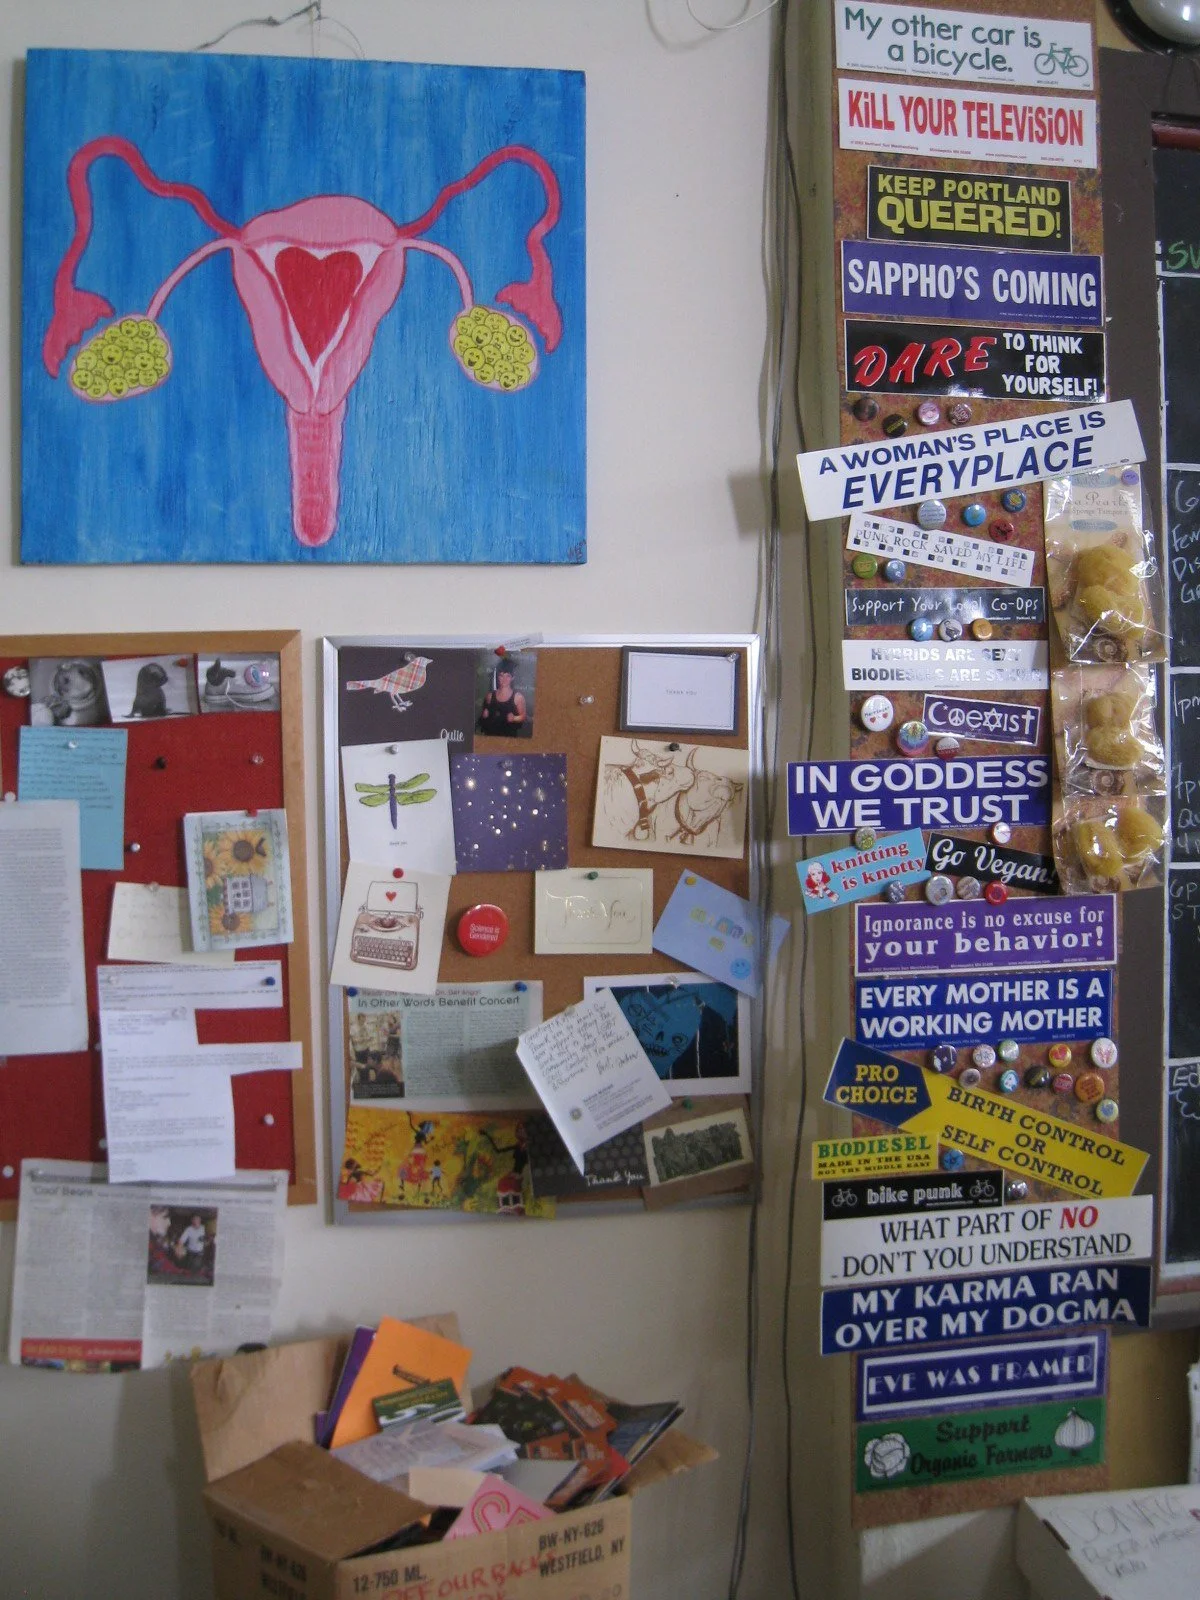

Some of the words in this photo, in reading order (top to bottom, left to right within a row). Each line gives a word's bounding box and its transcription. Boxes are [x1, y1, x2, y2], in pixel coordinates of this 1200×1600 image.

[845, 7, 882, 39] My
[892, 15, 963, 41] other
[971, 23, 1016, 47] car
[1023, 26, 1042, 49] is
[887, 43, 904, 62] a
[913, 40, 1013, 75] bicycle.
[899, 94, 958, 137] YOUR
[877, 173, 937, 197] KEEP
[943, 180, 1061, 207] PORTLAND
[877, 196, 1061, 239] QUEERED!
[848, 258, 981, 301] SAPPHO'S
[992, 268, 1097, 308] COMING
[1002, 332, 1025, 351] TO
[1030, 333, 1083, 355] THINK
[853, 336, 998, 387] DARE
[1025, 354, 1061, 374] FOR
[1001, 374, 1098, 397] YOURSELF!
[818, 456, 837, 476] A
[841, 433, 976, 470] WOMAN'S
[983, 419, 1074, 448] PLACE
[1077, 410, 1106, 432] IS
[842, 435, 1094, 510] EVERYPLACE
[855, 529, 888, 544] PUNK
[893, 536, 929, 551] ROCK
[933, 544, 972, 558] SAVED
[976, 551, 992, 563] MY
[997, 556, 1027, 571] LIFE
[852, 597, 905, 616] Support
[911, 597, 943, 611] Your
[991, 597, 1039, 615] Co-Ops
[871, 648, 939, 661] HYBRIDS
[945, 648, 975, 661] ARE
[982, 648, 1021, 661] SEXY
[950, 668, 980, 681] ARE
[795, 766, 838, 794] IN
[850, 761, 1049, 792] GODDESS
[811, 799, 882, 828] WE
[894, 794, 1030, 825] TRUST
[831, 841, 910, 874] knitting
[841, 875, 858, 891] is
[862, 856, 926, 887] knotty
[932, 838, 967, 871] Go
[974, 845, 1058, 884] Vegan!
[865, 915, 954, 937] Ignorance
[962, 911, 977, 929] is
[985, 913, 1005, 928] no
[1013, 910, 1072, 926] excuse
[1079, 906, 1105, 924] for
[865, 938, 939, 964] your
[954, 926, 1104, 954] behavior!
[358, 998, 368, 1008] In
[370, 999, 400, 1008] Other
[402, 998, 436, 1008] Words
[439, 997, 476, 1007] Benefit
[479, 995, 521, 1006] Concert
[860, 984, 938, 1010] EVERY
[946, 979, 1050, 1006] MOTHER
[1058, 978, 1079, 999] IS
[1086, 977, 1105, 999] A
[861, 1011, 993, 1039] WORKING
[1000, 1006, 1103, 1032] MOTHER
[855, 1064, 899, 1082] PRO
[836, 1086, 918, 1103] CHOICE
[946, 1086, 1016, 1124] BIRTH
[1019, 1114, 1126, 1167] CONTROL
[1015, 1133, 1047, 1154] OR
[817, 1136, 931, 1158] BIODIESEL
[817, 1160, 851, 1168] MADE
[858, 1158, 871, 1166] IN
[876, 1155, 901, 1163] THE
[941, 1125, 995, 1154] SELF
[997, 1145, 1104, 1196] CONTROL
[865, 1163, 902, 1172] MIDDLE
[867, 1185, 909, 1205] bike
[913, 1182, 963, 1206] punk
[880, 1217, 951, 1244] WHAT
[956, 1211, 1015, 1237] PART
[1021, 1208, 1053, 1231] OF
[1060, 1205, 1099, 1230] NO
[842, 1251, 918, 1278] DON'T
[922, 1246, 974, 1270] YOU
[980, 1232, 1132, 1266] UNDERSTAND
[852, 1288, 906, 1316] MY
[915, 1274, 1036, 1308] KARMA
[1050, 1268, 1119, 1295] RAN
[835, 1316, 928, 1347] OVER
[941, 1309, 991, 1336] MY
[1003, 1298, 1136, 1331] DOGMA
[868, 1373, 917, 1396] EVE
[926, 1365, 982, 1389] WAS
[990, 1355, 1094, 1383] FRAMED
[936, 1415, 1031, 1444] Support
[911, 1445, 978, 1478] Organic
[985, 1442, 1053, 1467] Farmers
[610, 1536, 627, 1556] NY
